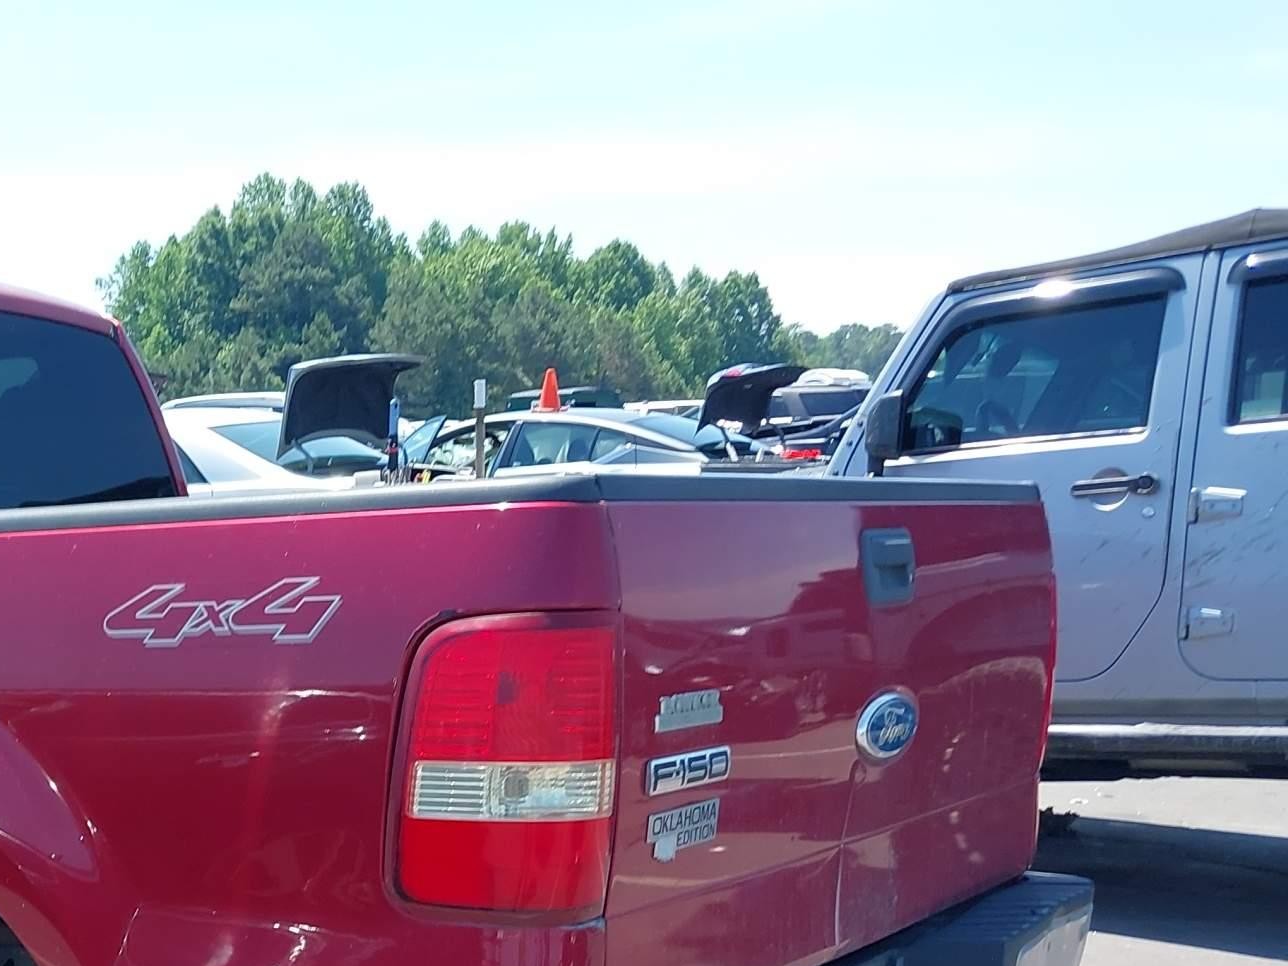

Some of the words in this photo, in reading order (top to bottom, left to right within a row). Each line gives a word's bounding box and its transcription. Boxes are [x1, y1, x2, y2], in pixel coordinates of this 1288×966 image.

[878, 707, 912, 746] Ford
[652, 802, 717, 836] OKLAHOMA
[676, 824, 716, 847] EDITION
